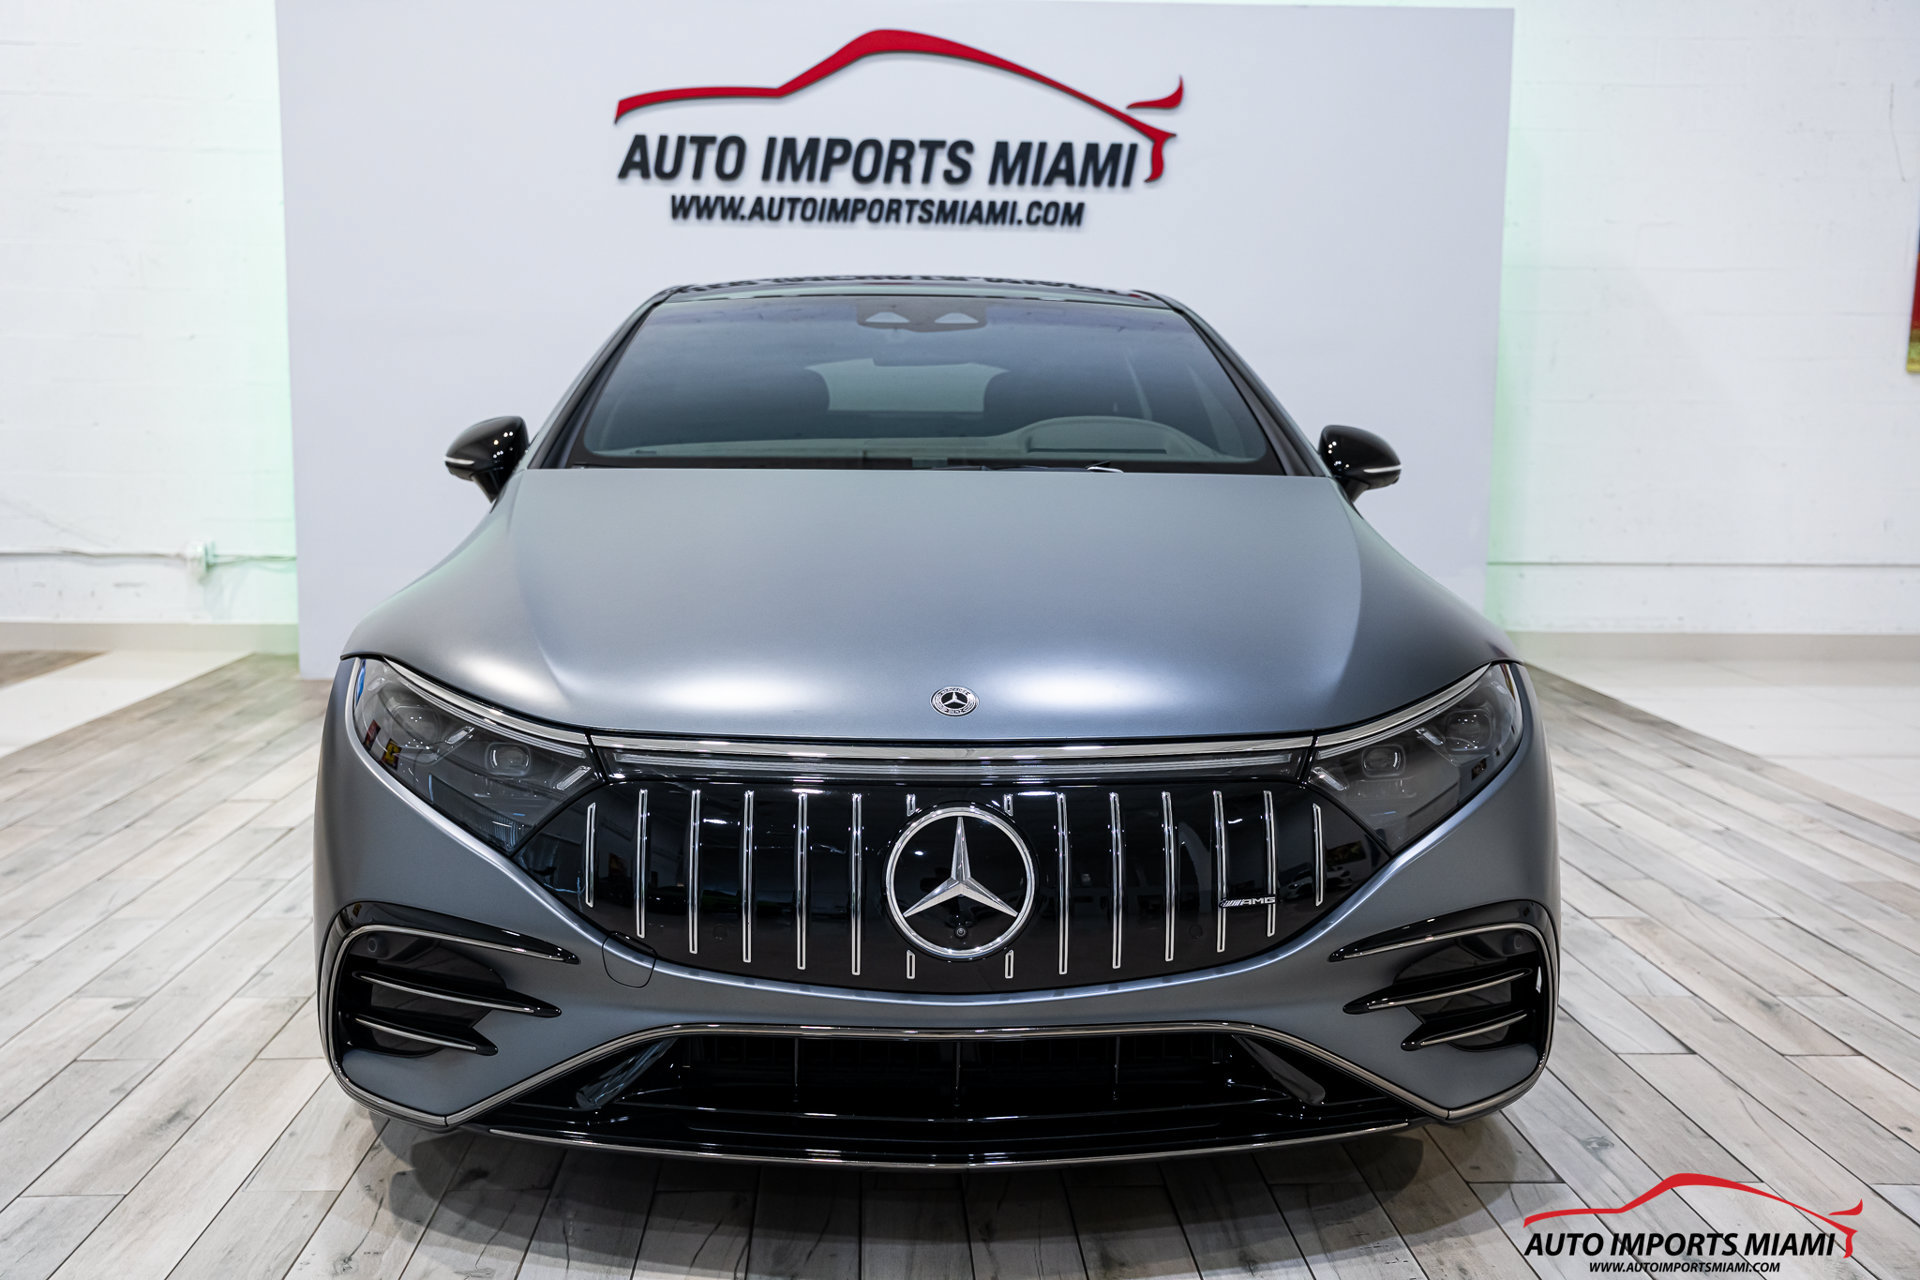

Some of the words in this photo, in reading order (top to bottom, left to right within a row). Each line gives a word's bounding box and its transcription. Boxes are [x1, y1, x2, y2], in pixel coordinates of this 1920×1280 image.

[618, 135, 746, 181] AUTO
[762, 137, 973, 185] IMPORTS
[989, 142, 1138, 188] MIAMI
[671, 195, 1084, 226] WWW.AUTOIMPORTSMIAMI.COM
[1240, 896, 1276, 906] AMG
